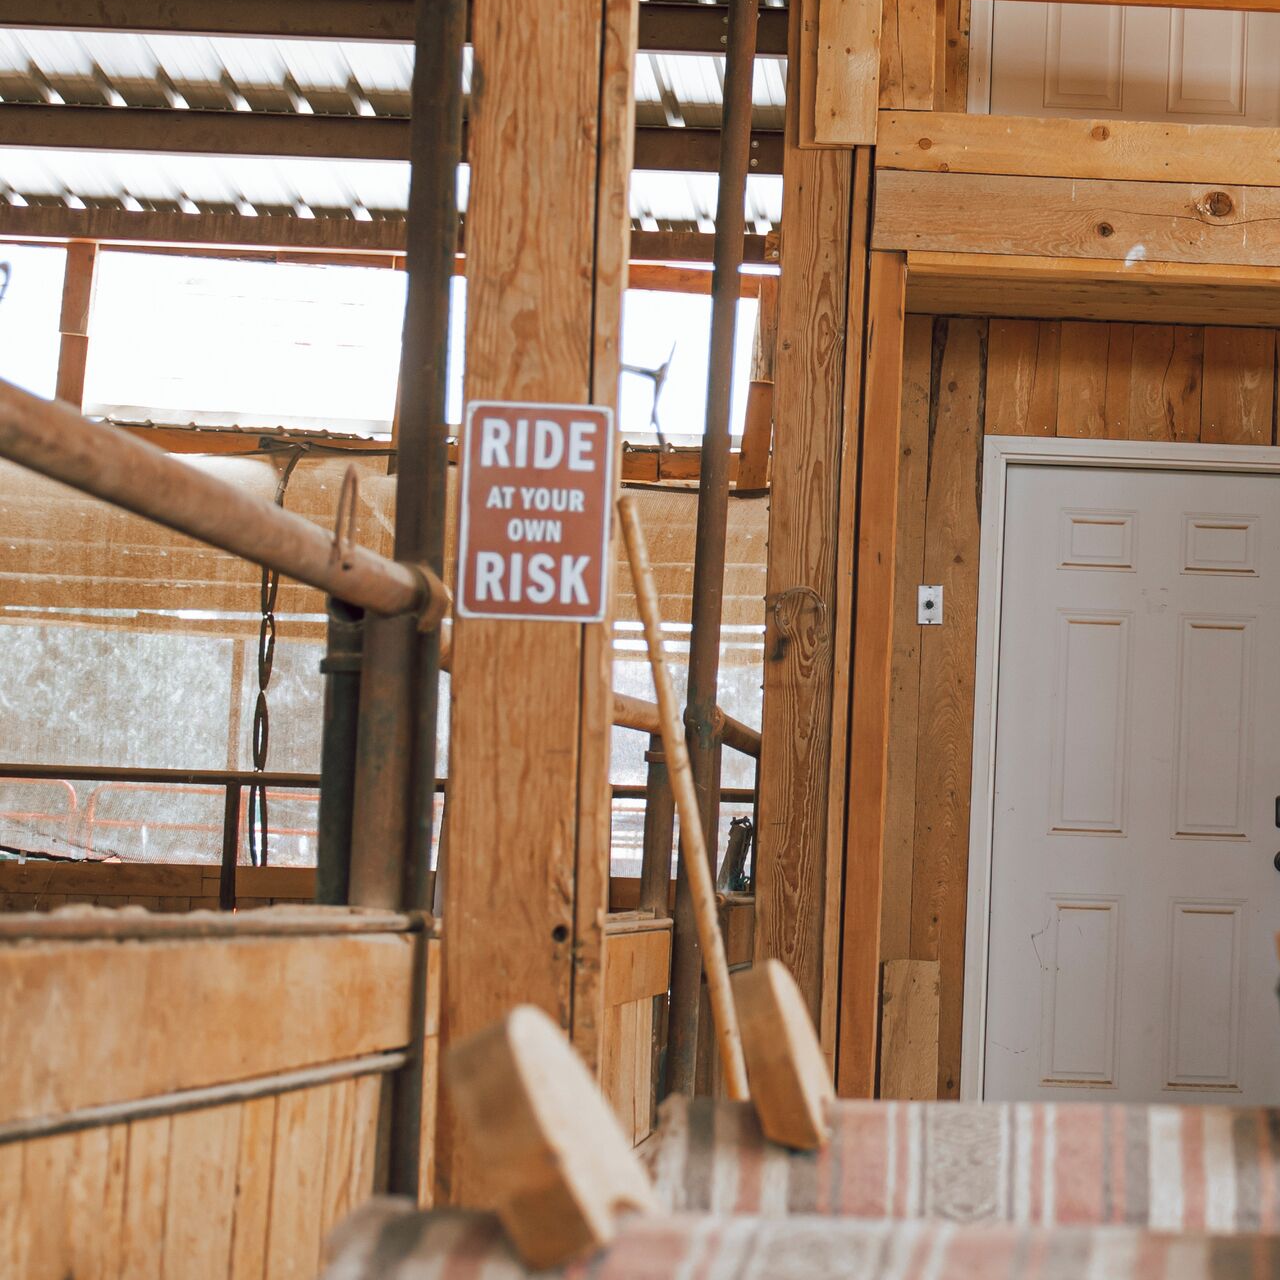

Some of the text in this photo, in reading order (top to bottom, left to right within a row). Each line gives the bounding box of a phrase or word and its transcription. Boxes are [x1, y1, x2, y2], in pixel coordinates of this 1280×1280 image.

[481, 417, 598, 472] RIDE
[486, 485, 586, 513] AT YOUR
[507, 518, 562, 543] OWN
[475, 550, 592, 606] RISK
